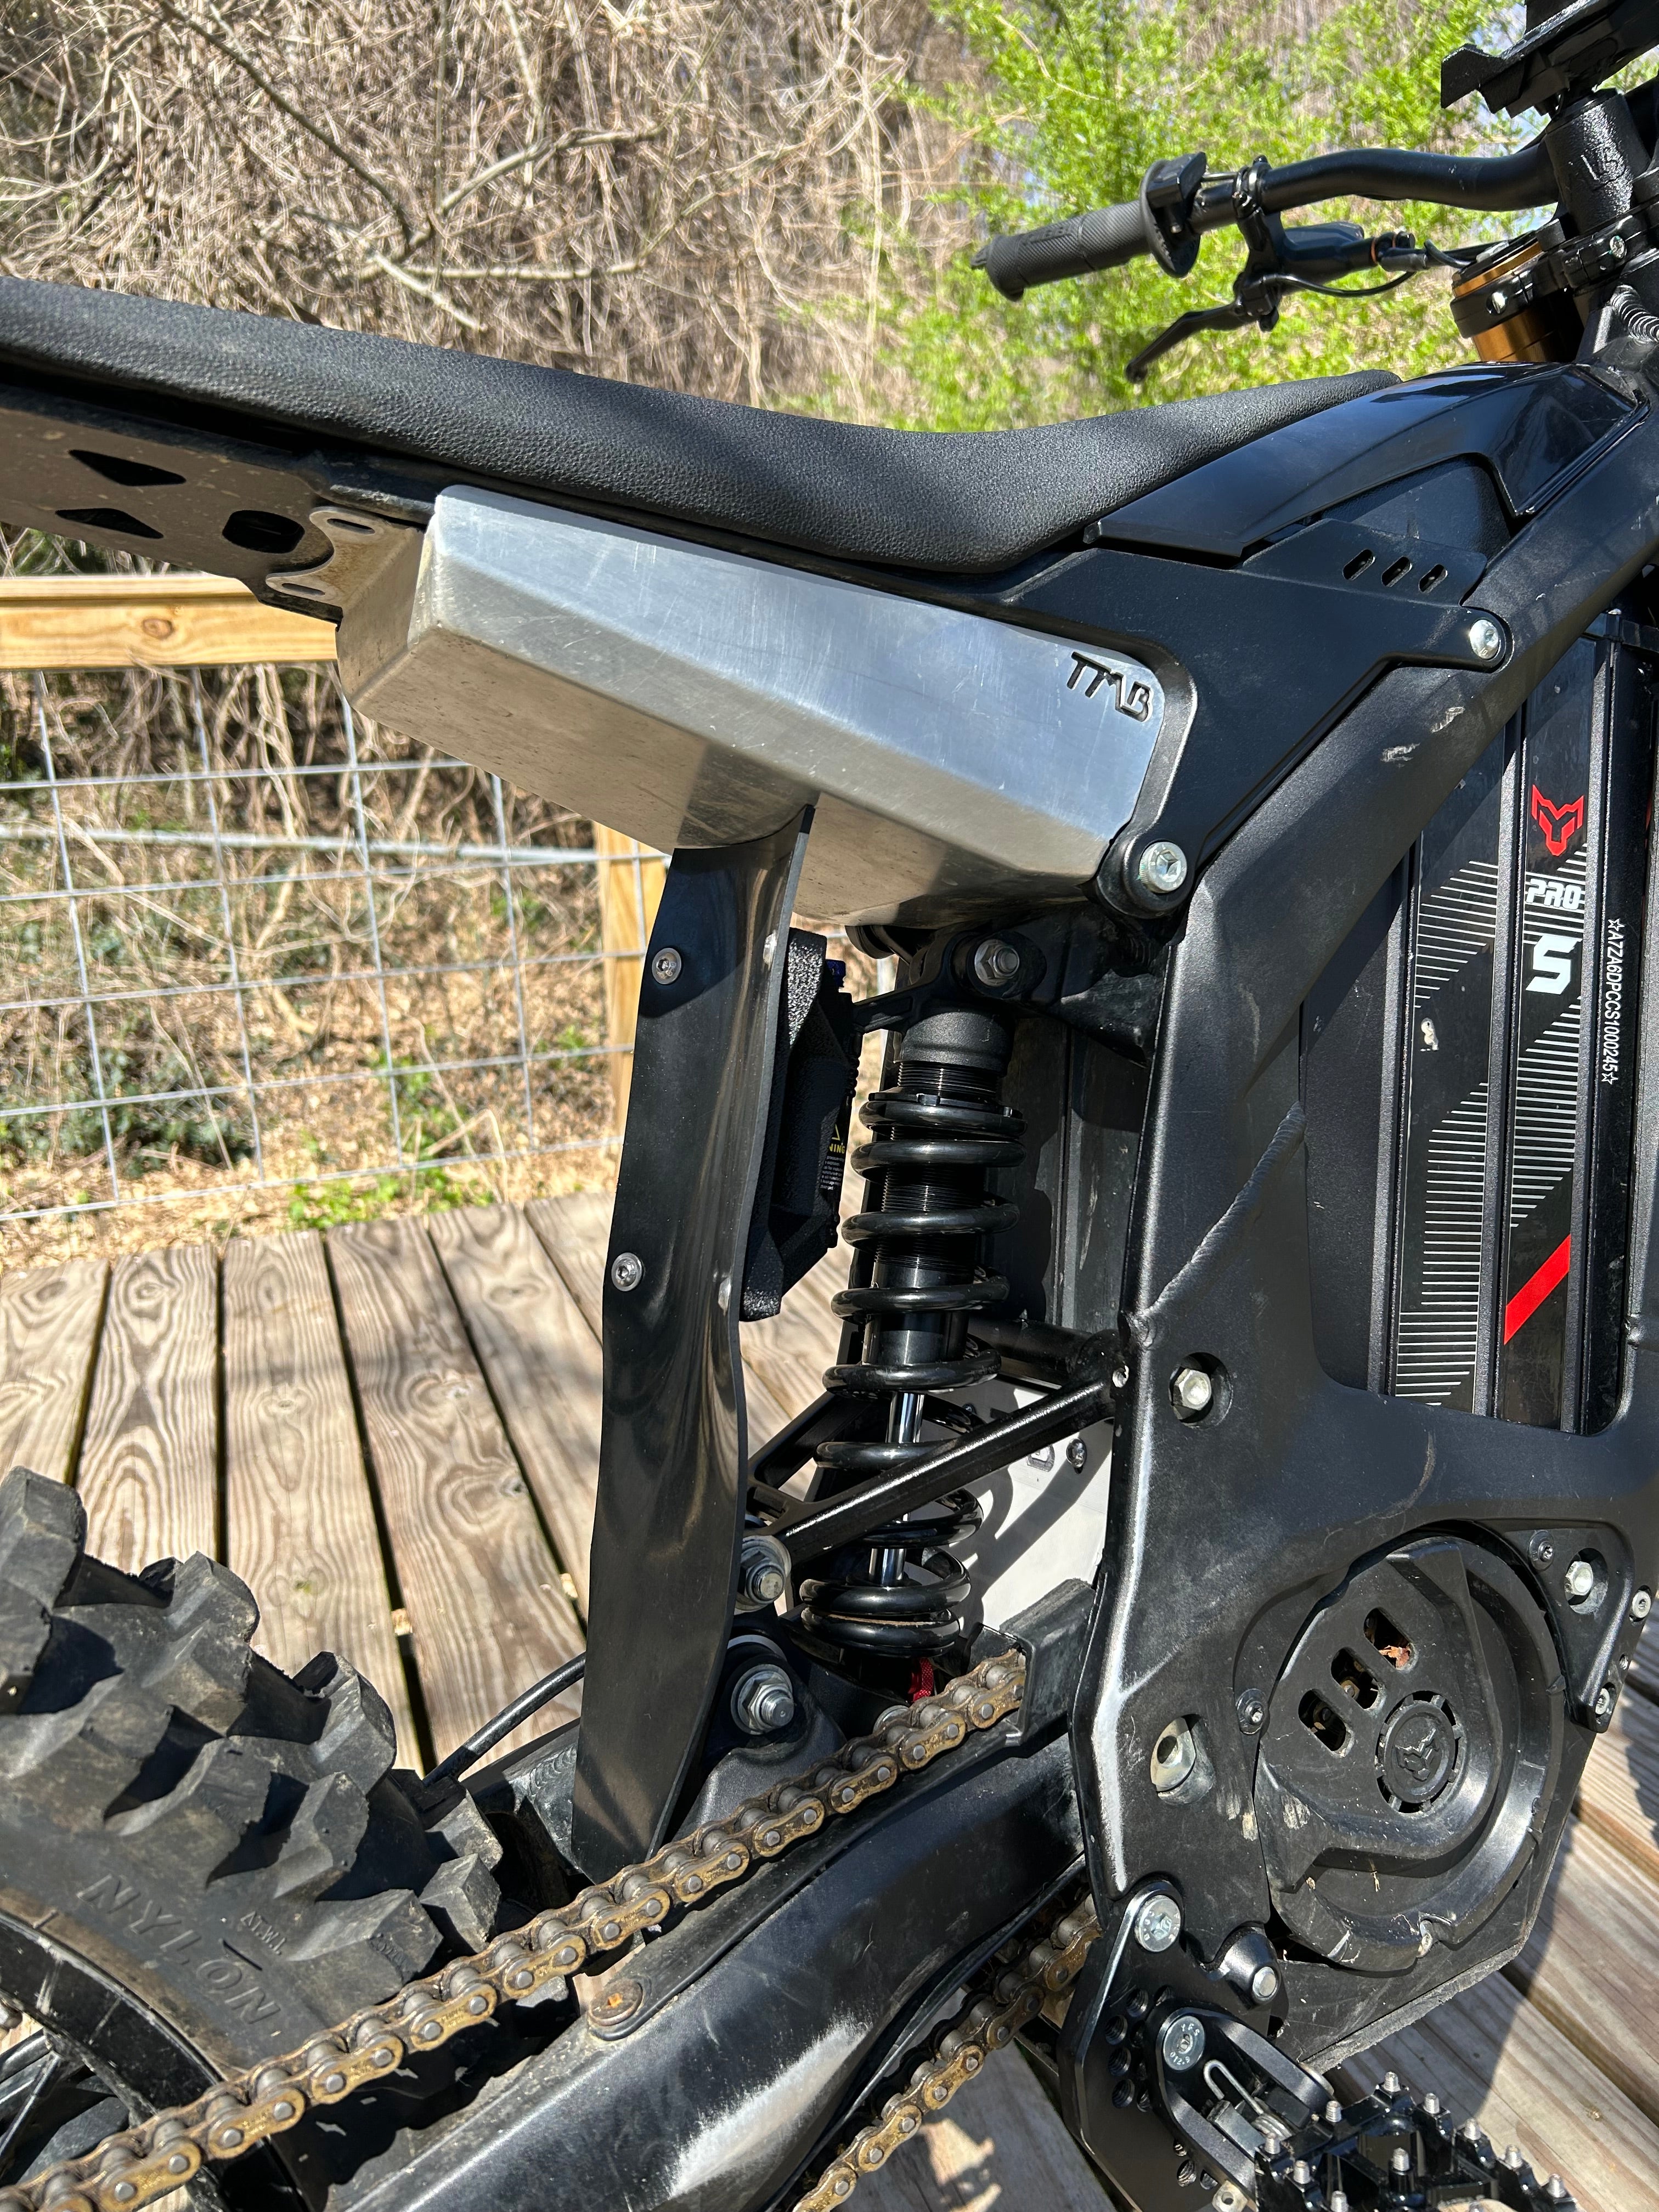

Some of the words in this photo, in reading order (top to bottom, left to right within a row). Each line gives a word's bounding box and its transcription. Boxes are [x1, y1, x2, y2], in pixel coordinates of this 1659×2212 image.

[1066, 651, 1153, 722] TMB
[1526, 878, 1582, 910] PRO
[76, 1874, 280, 2024] NYLON
